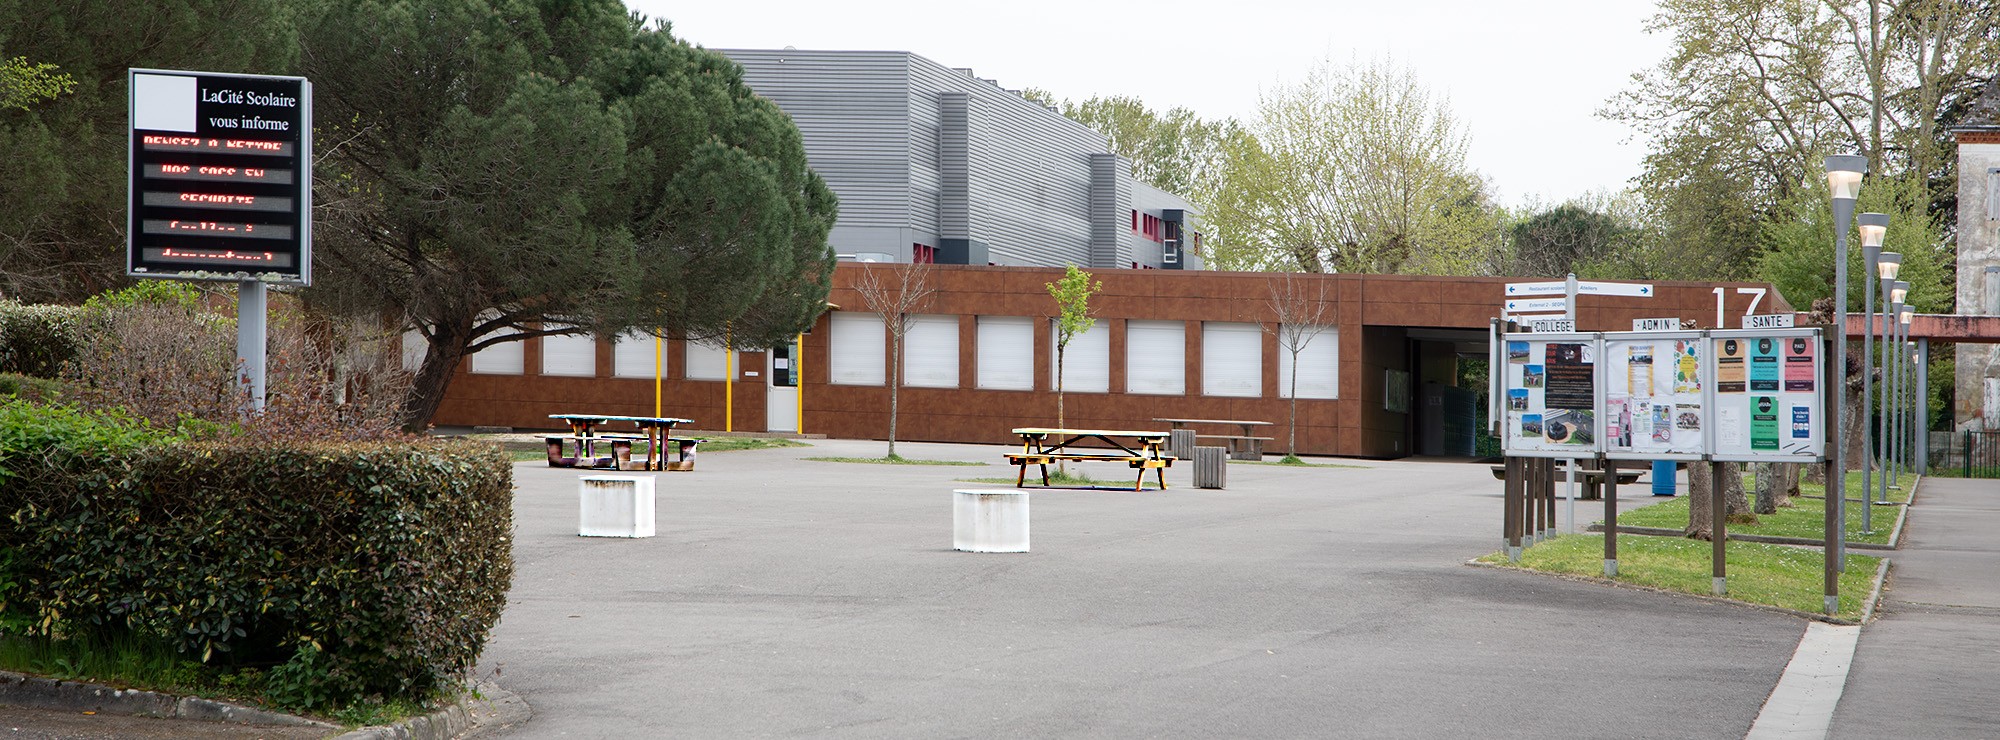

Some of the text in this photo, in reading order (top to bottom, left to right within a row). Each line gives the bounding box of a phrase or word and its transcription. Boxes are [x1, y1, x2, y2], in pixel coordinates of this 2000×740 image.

[202, 88, 296, 107] LaCité Scolaire
[209, 115, 289, 131] vous informe
[1712, 287, 1767, 329] 17
[1535, 321, 1571, 332] COLLEGE
[1642, 319, 1670, 331] ADMIN
[1752, 316, 1782, 328] SANTE
